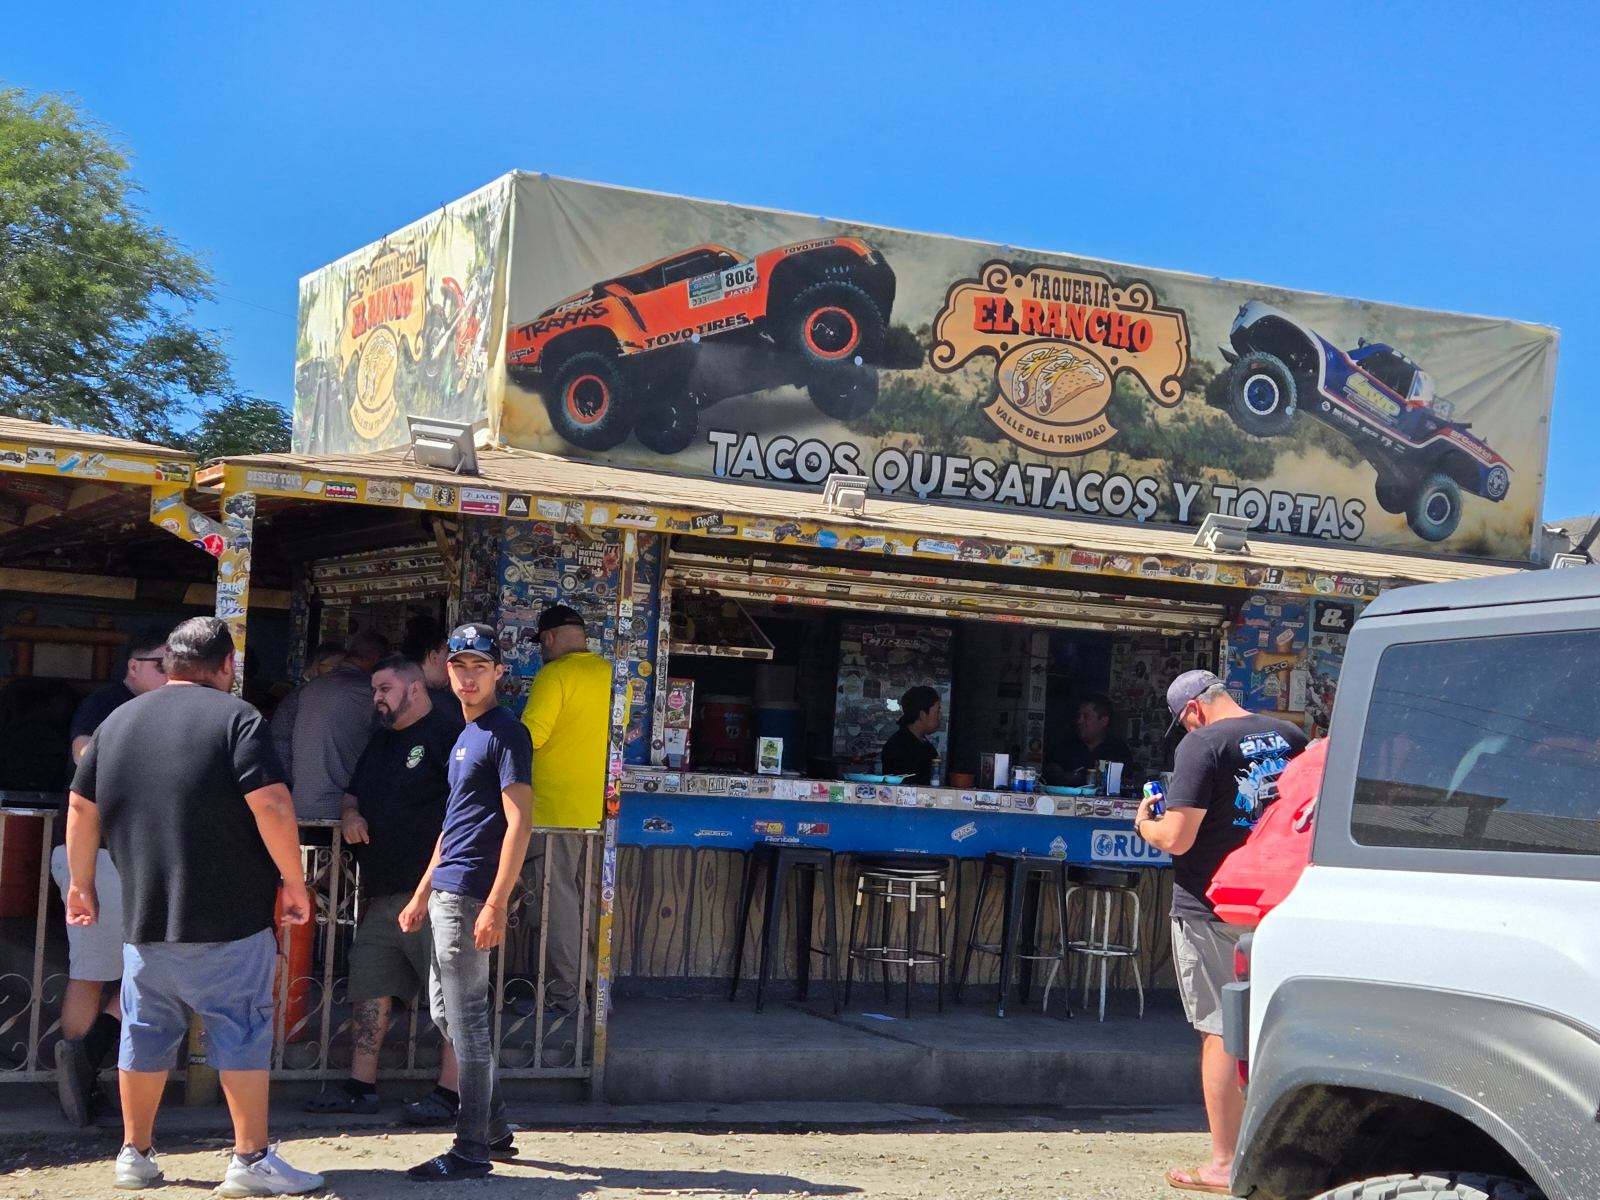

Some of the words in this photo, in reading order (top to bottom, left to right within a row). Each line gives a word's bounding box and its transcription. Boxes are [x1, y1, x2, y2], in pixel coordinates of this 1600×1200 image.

[1030, 272, 1110, 308] TAQUERIA
[644, 328, 694, 348] TOYO
[696, 313, 750, 334] TIRES
[973, 296, 1018, 334] EL
[1020, 299, 1154, 353] RANCHO
[996, 406, 1025, 433] VALLE
[1025, 427, 1040, 440] DE
[1041, 432, 1055, 443] LA
[1057, 423, 1106, 444] TRINIDAD
[708, 430, 862, 484] TACOS
[872, 446, 1160, 519] QUESATACOS
[1173, 481, 1202, 525] Y
[1211, 484, 1366, 541] TORTAS
